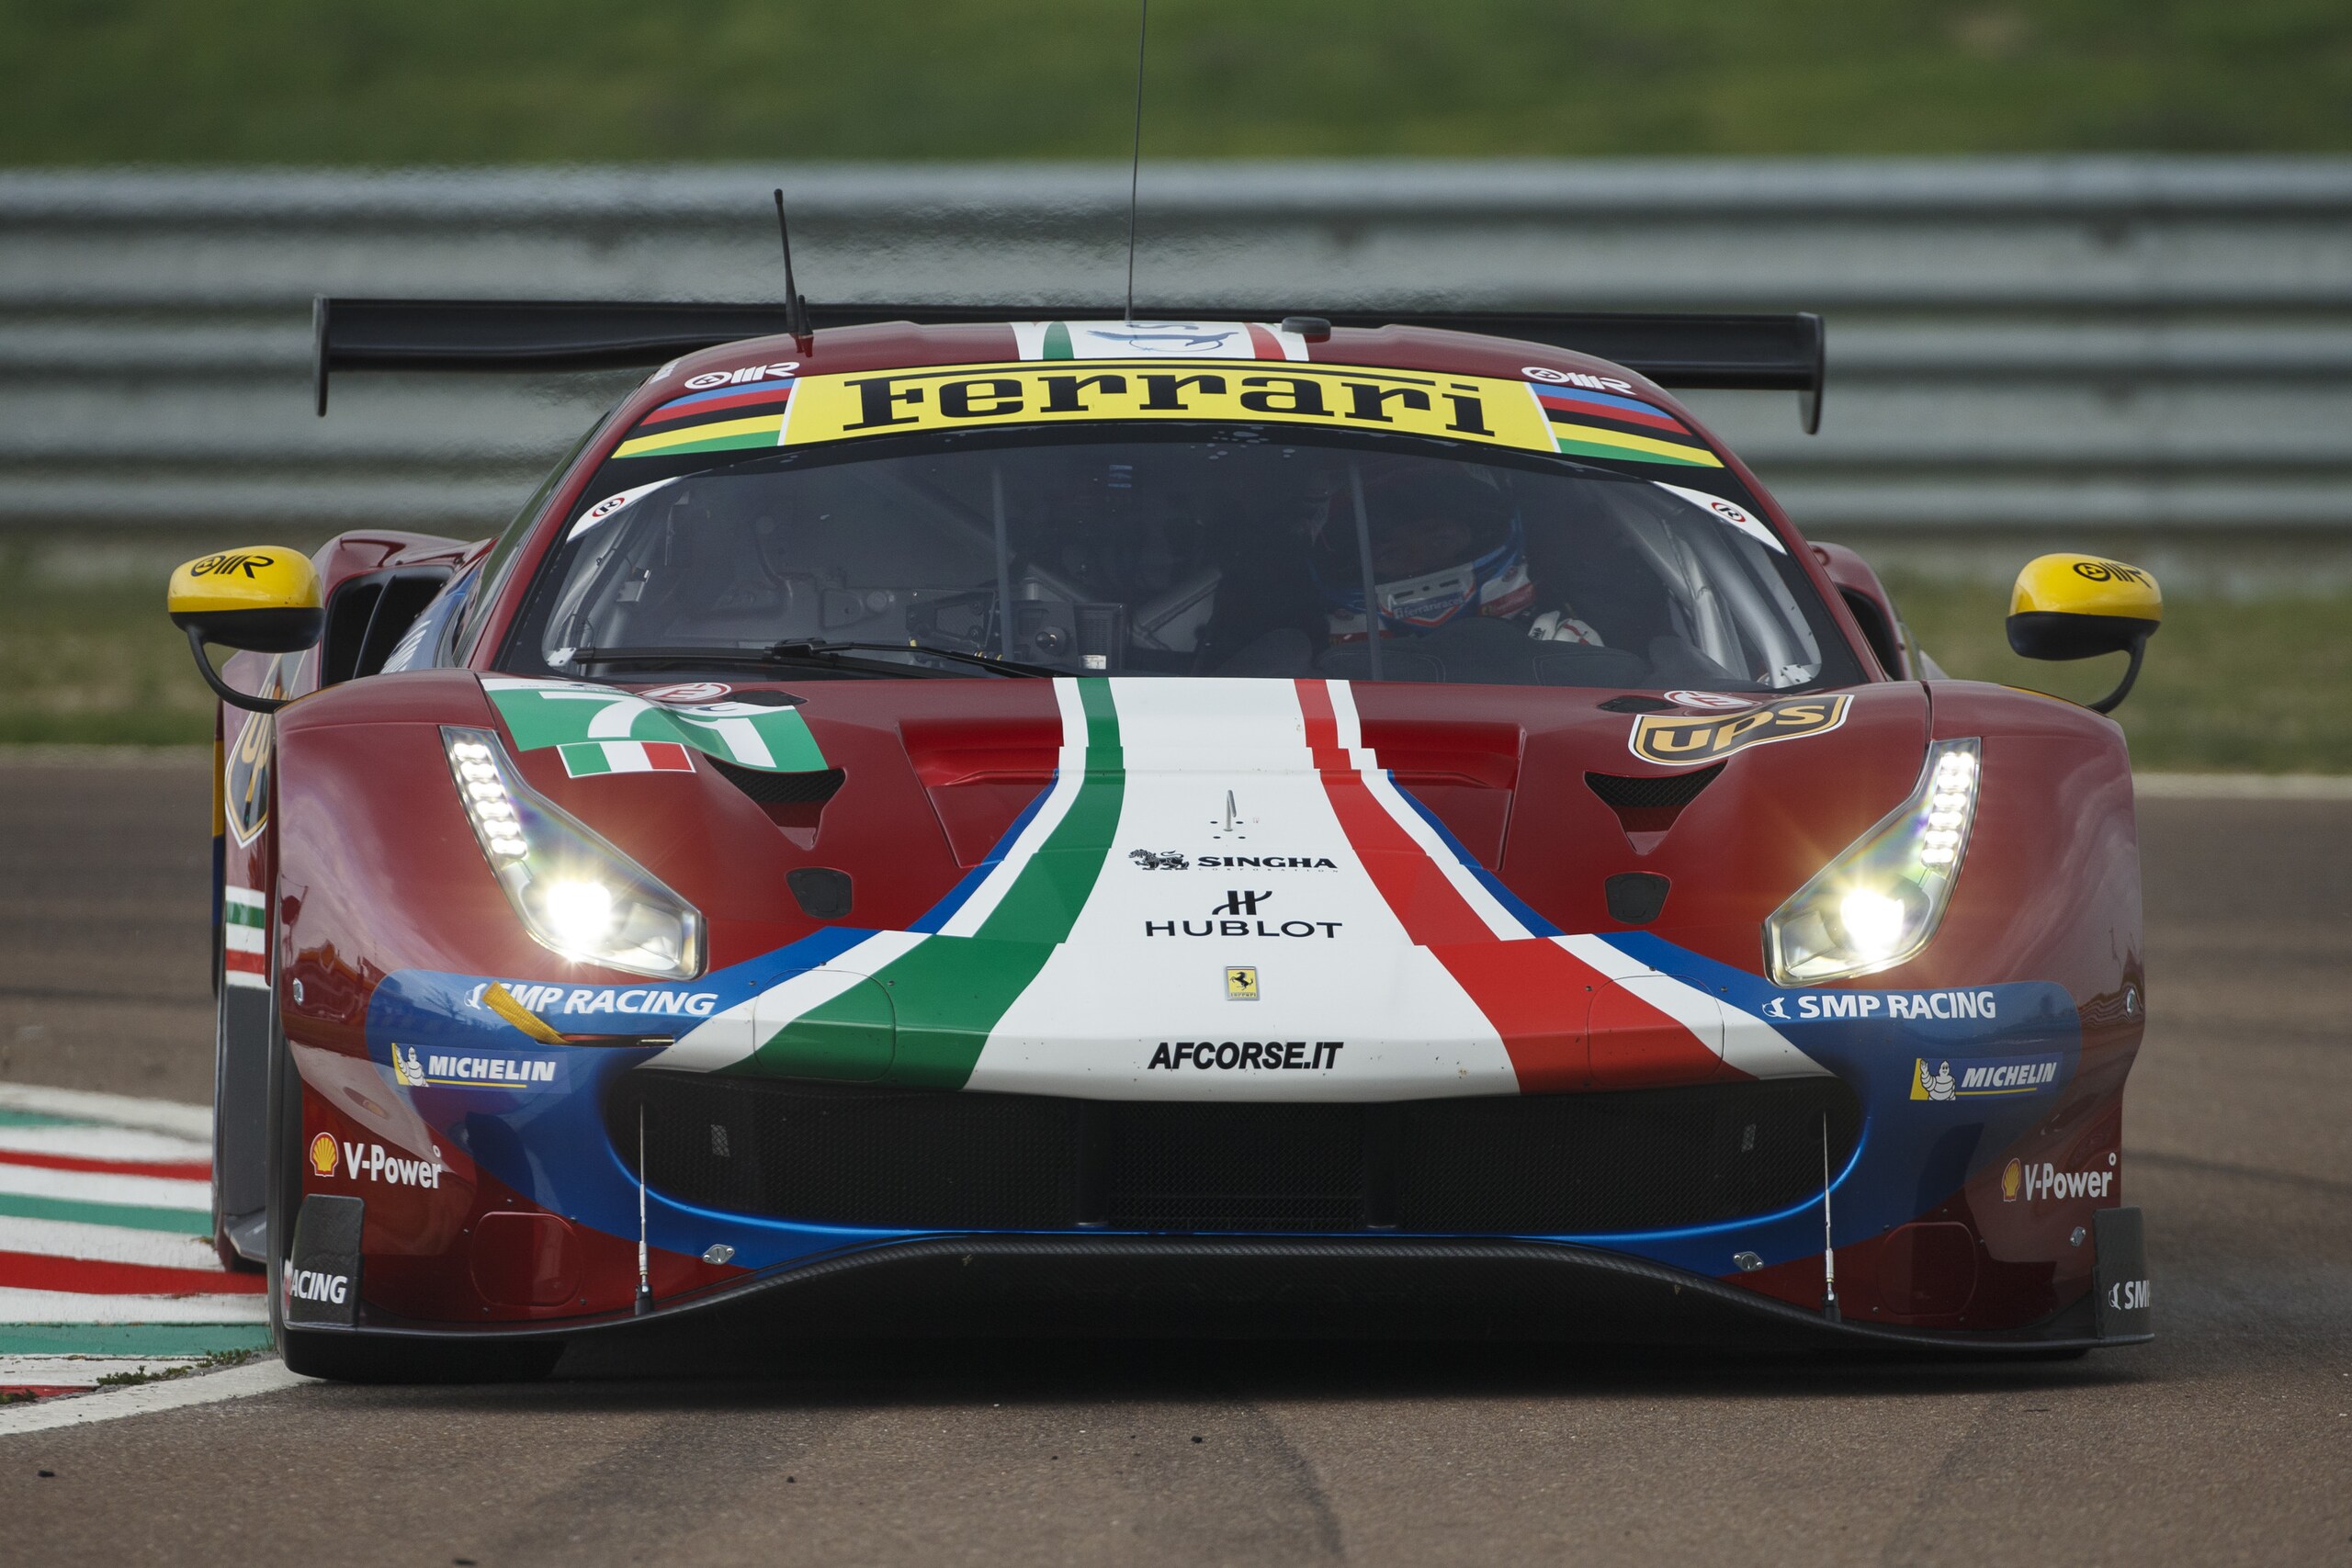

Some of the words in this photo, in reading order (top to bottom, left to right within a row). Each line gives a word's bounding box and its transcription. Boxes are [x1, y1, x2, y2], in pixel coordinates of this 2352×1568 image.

[842, 365, 1496, 438] Ferrari
[538, 691, 777, 768] 71
[1197, 856, 1338, 868] SINGHA
[1145, 920, 1342, 938] HUBLOT
[563, 988, 718, 1016] RACING
[1798, 995, 1881, 1019] SMP
[1888, 991, 1996, 1020] RACING
[428, 1055, 556, 1082] MICHELIN
[1148, 1042, 1344, 1069] AFCORSE.IT
[1961, 1062, 2057, 1088] MICHELIN
[344, 1142, 441, 1189] V-Power
[2024, 1162, 2113, 1201] V-Power
[289, 1269, 348, 1304] ACING
